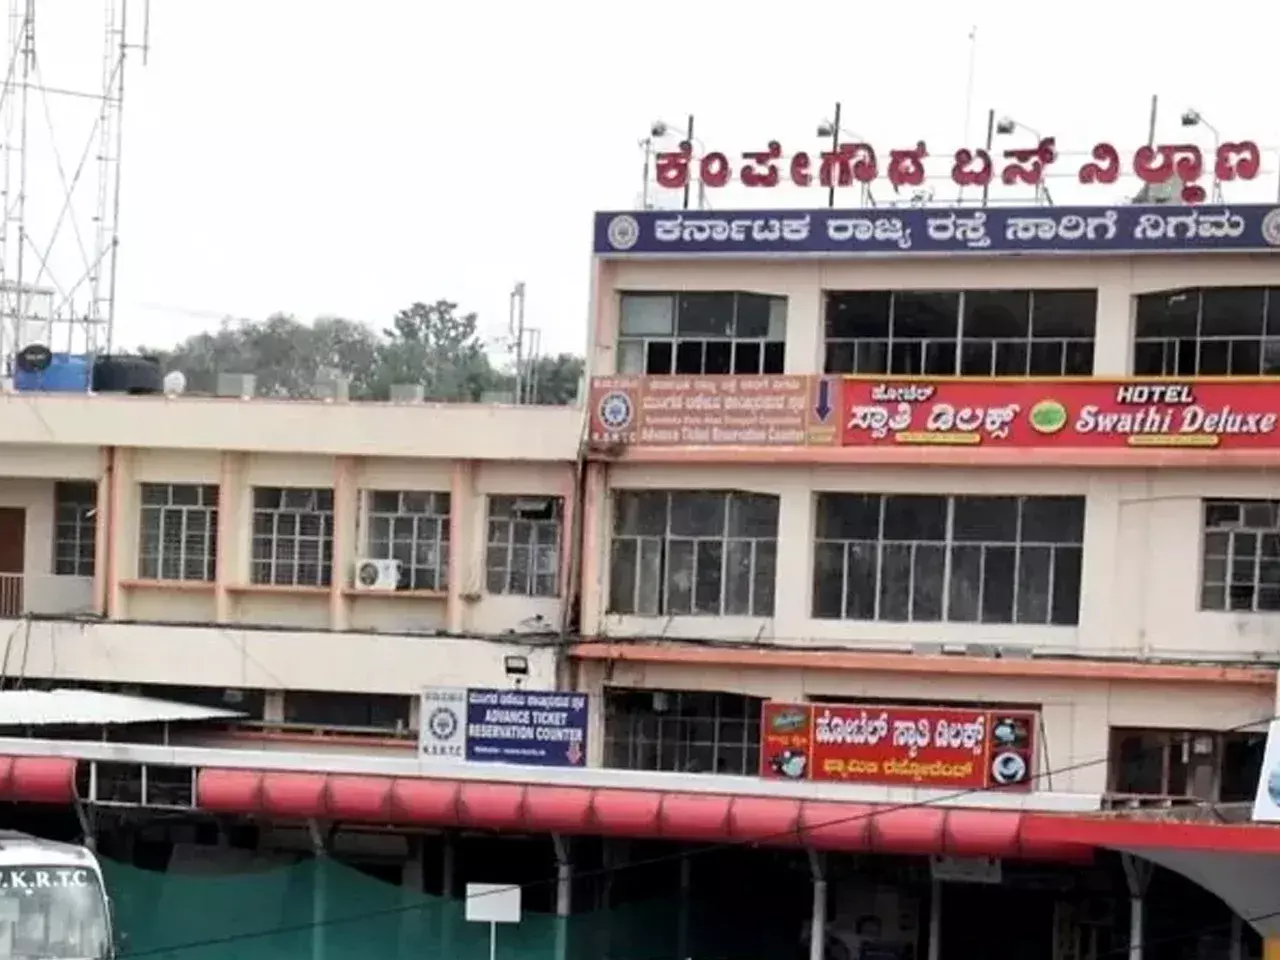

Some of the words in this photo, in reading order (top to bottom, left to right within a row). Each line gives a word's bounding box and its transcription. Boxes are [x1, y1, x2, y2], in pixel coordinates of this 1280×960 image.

[951, 137, 1057, 185] ಬಸ್
[1078, 140, 1260, 204] ನಿಲ್ದಾಣ
[654, 214, 811, 241] ಕರ್ನಾಟಕ
[827, 216, 912, 248] ರಾಜ್ಯ
[927, 211, 990, 247] ರಸ್ತೆ
[1006, 210, 1118, 239] ಸಾರಿಗೆ
[1133, 210, 1245, 239] ನಿಗಮ
[1117, 386, 1194, 403] HOTEL
[848, 402, 912, 439] ಸ್ವಾತಿ
[1075, 405, 1173, 432] Swathi
[1180, 404, 1277, 433] Deluxe
[485, 709, 530, 724] ADVANCE
[531, 711, 568, 725] TICKET
[469, 724, 534, 740] RESERVATION
[536, 727, 583, 741] COUNTER
